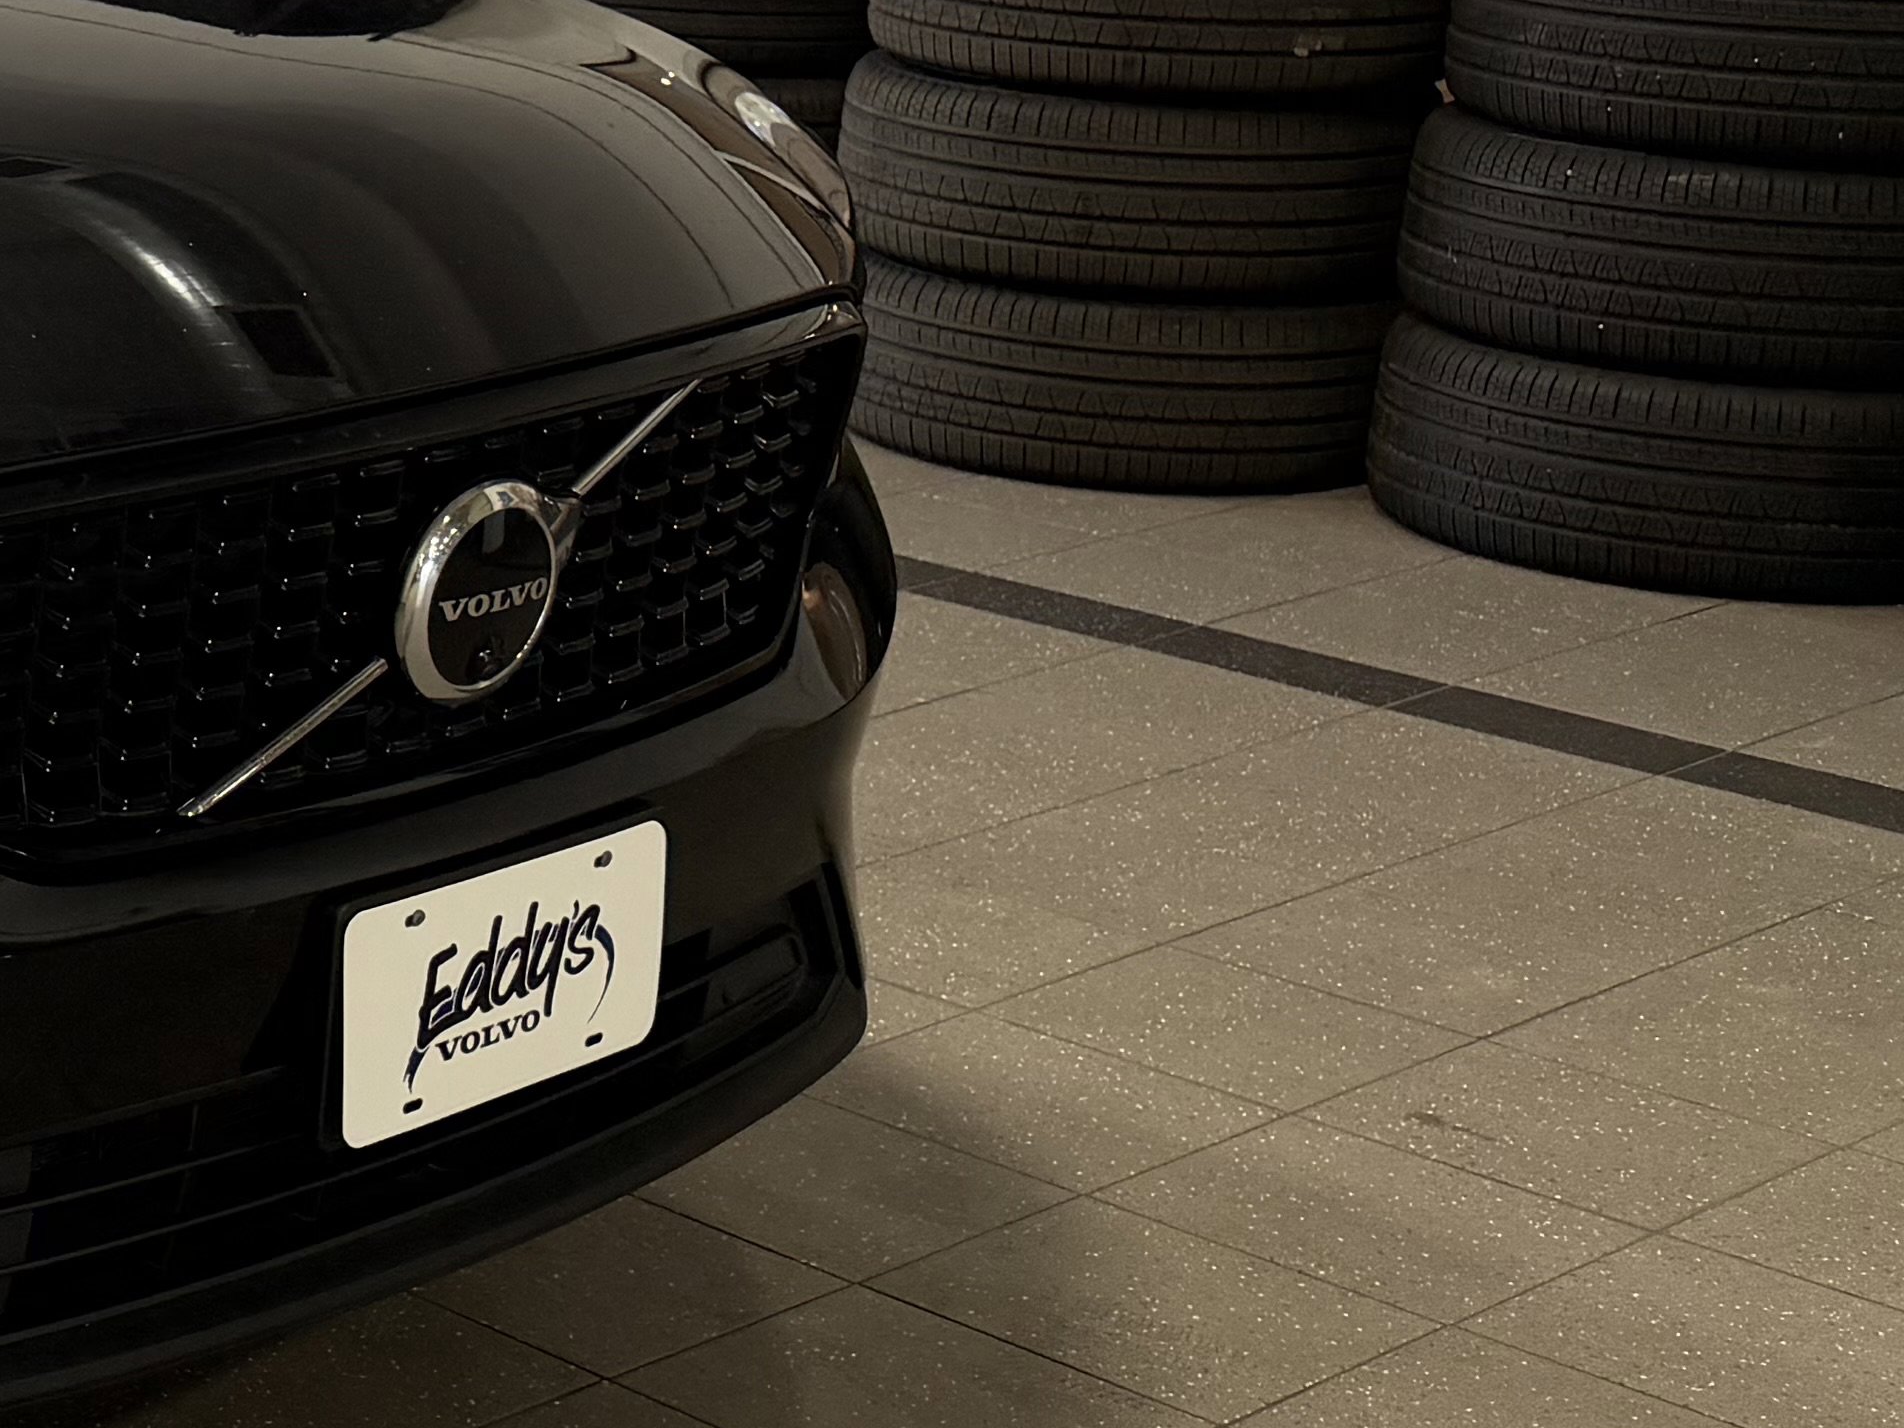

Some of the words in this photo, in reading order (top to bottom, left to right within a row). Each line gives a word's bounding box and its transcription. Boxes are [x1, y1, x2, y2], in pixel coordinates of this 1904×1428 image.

[437, 575, 549, 624] VOLVO
[416, 898, 603, 1050] Eddy's
[435, 1009, 542, 1063] VOLVO
